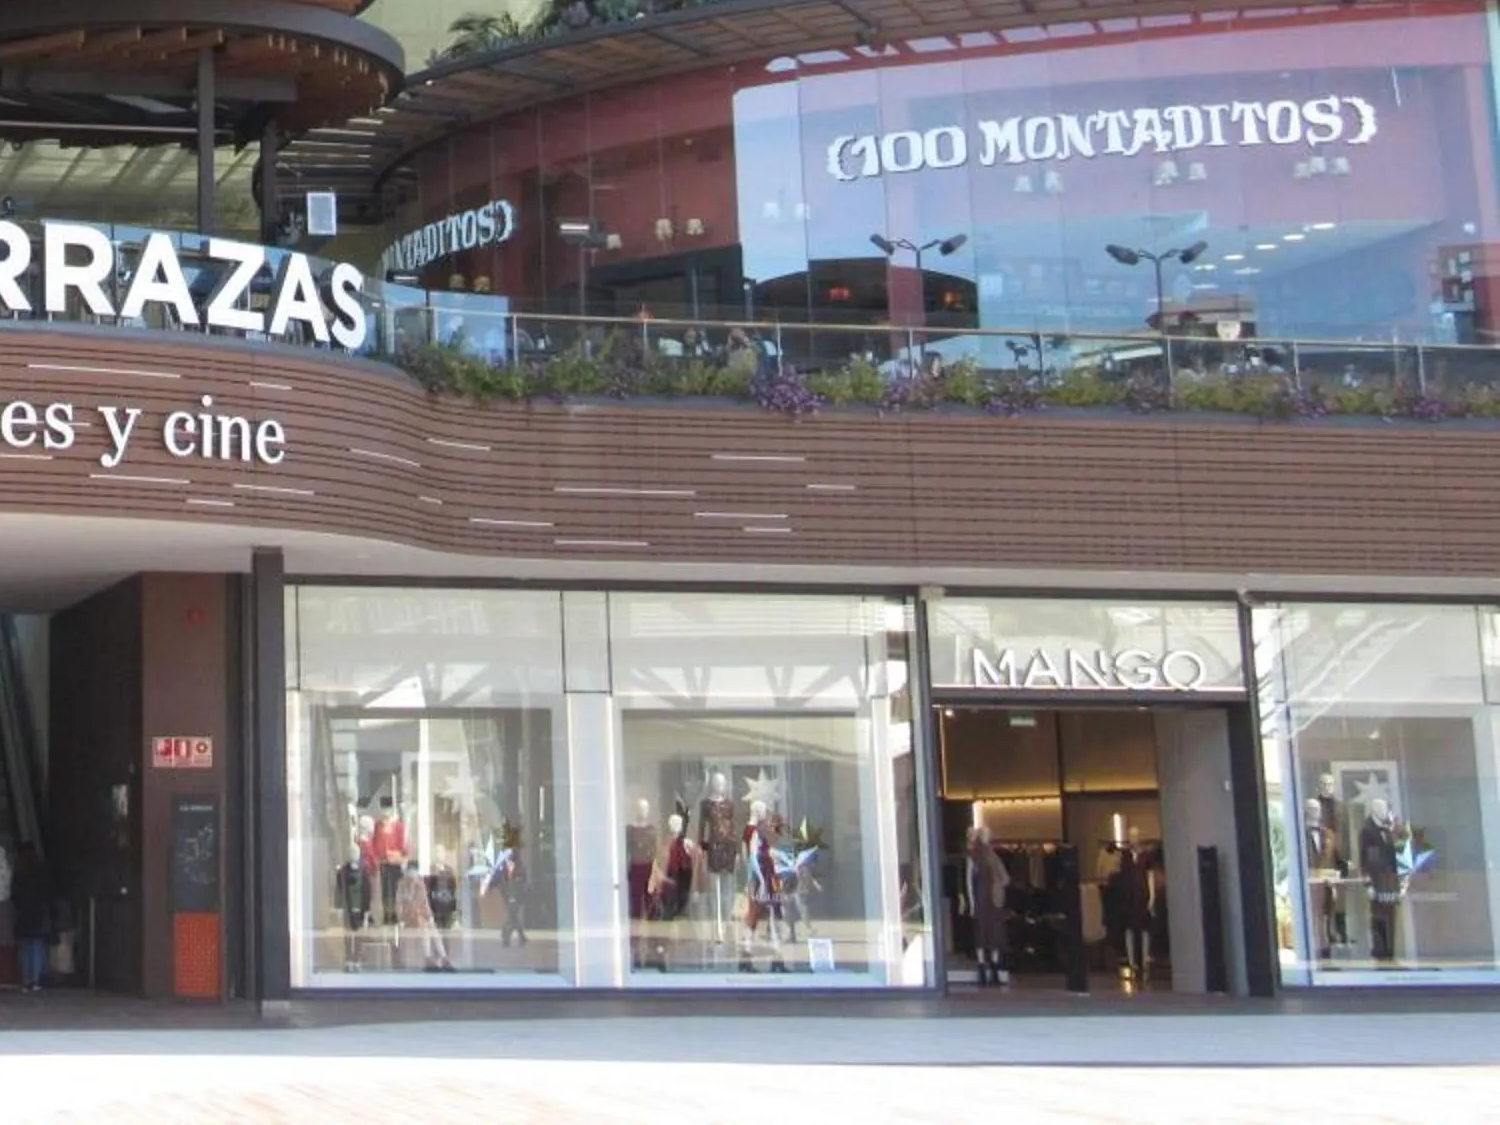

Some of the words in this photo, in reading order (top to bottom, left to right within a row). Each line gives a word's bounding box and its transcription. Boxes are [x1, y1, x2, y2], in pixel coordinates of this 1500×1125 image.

[97, 405, 143, 469] y
[163, 393, 287, 465] cine
[971, 647, 1206, 692] MANGO
